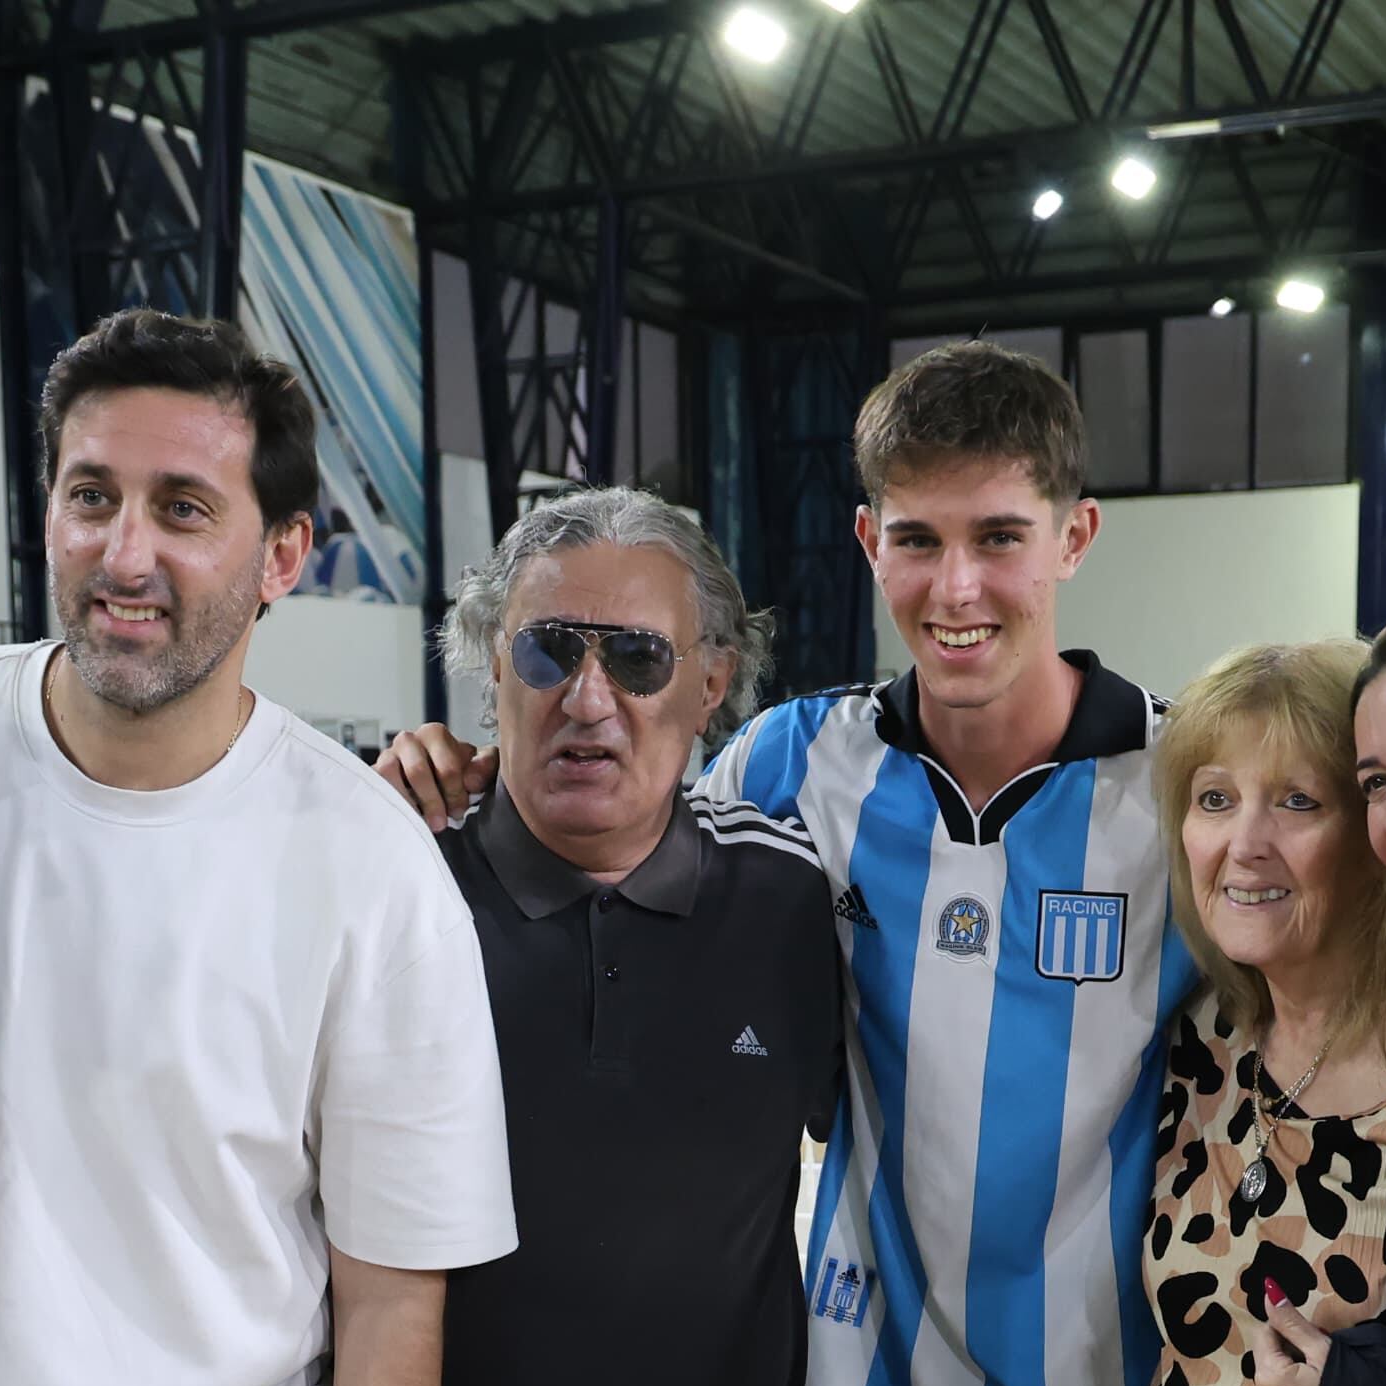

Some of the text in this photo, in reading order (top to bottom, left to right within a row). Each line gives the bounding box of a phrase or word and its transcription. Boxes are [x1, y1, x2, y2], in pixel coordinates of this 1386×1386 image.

[1048, 901, 1117, 916] RACING
[835, 904, 878, 930] adidas
[731, 1043, 768, 1056] adidas
